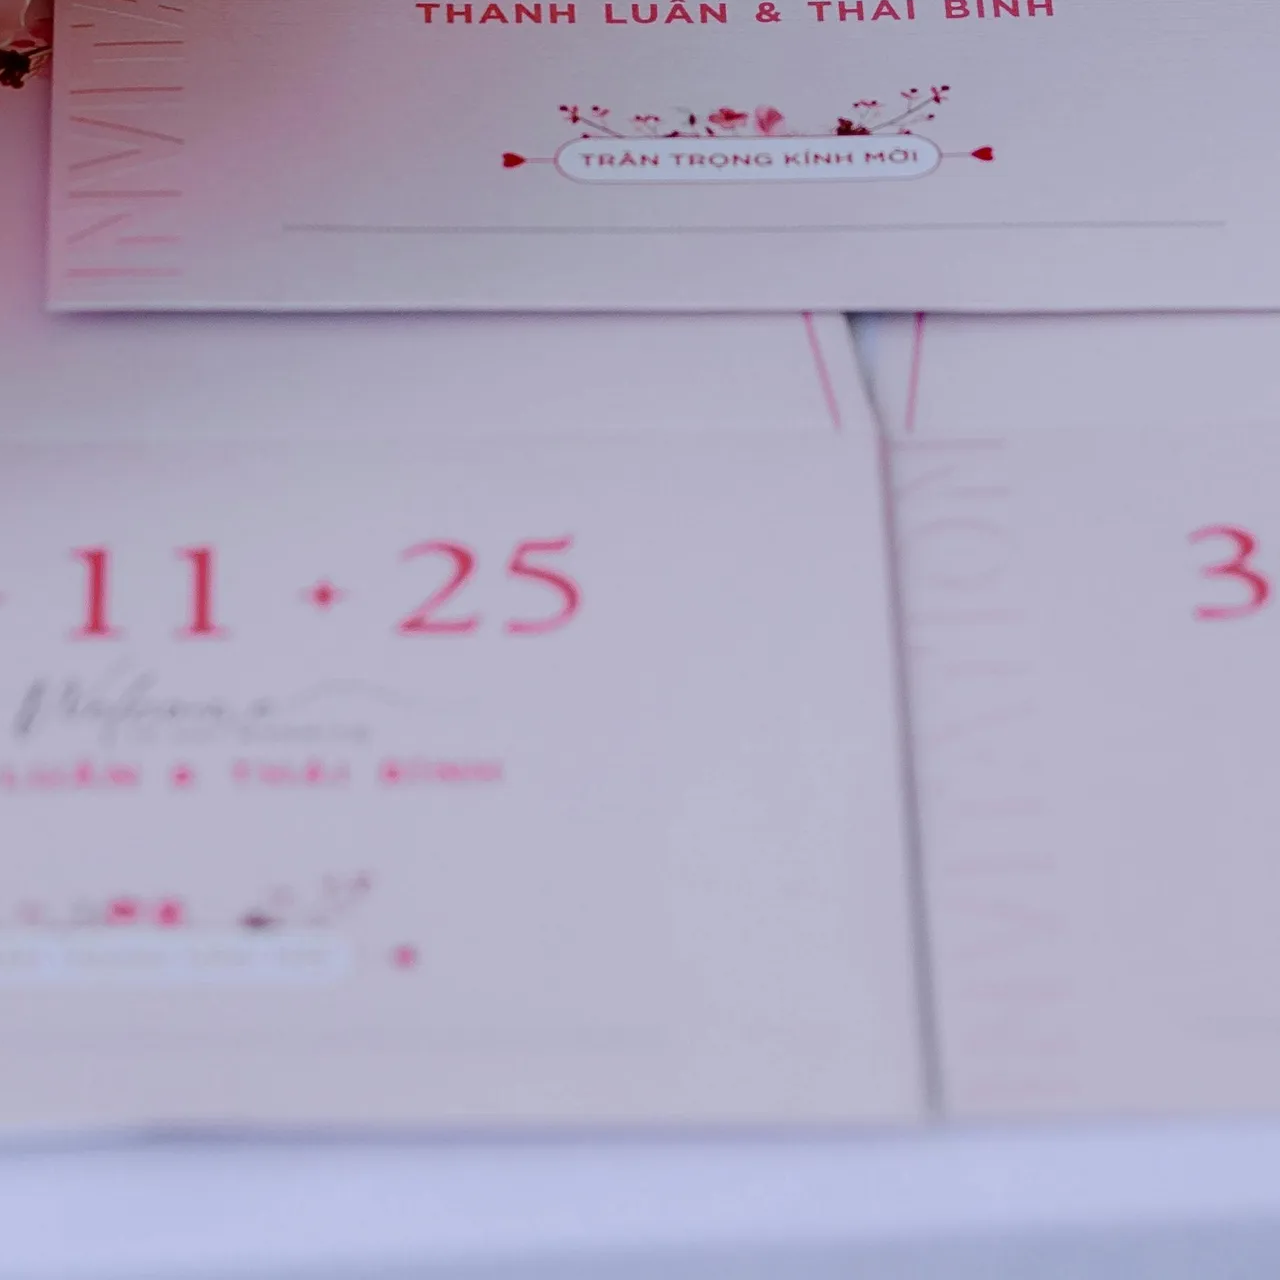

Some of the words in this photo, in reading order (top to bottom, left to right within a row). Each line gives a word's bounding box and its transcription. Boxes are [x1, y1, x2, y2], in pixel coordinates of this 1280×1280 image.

[415, 2, 576, 24] THANH
[753, 0, 782, 24] &
[783, 147, 854, 167] KÍNH
[72, 543, 225, 640] 11
[397, 535, 583, 637] 25
